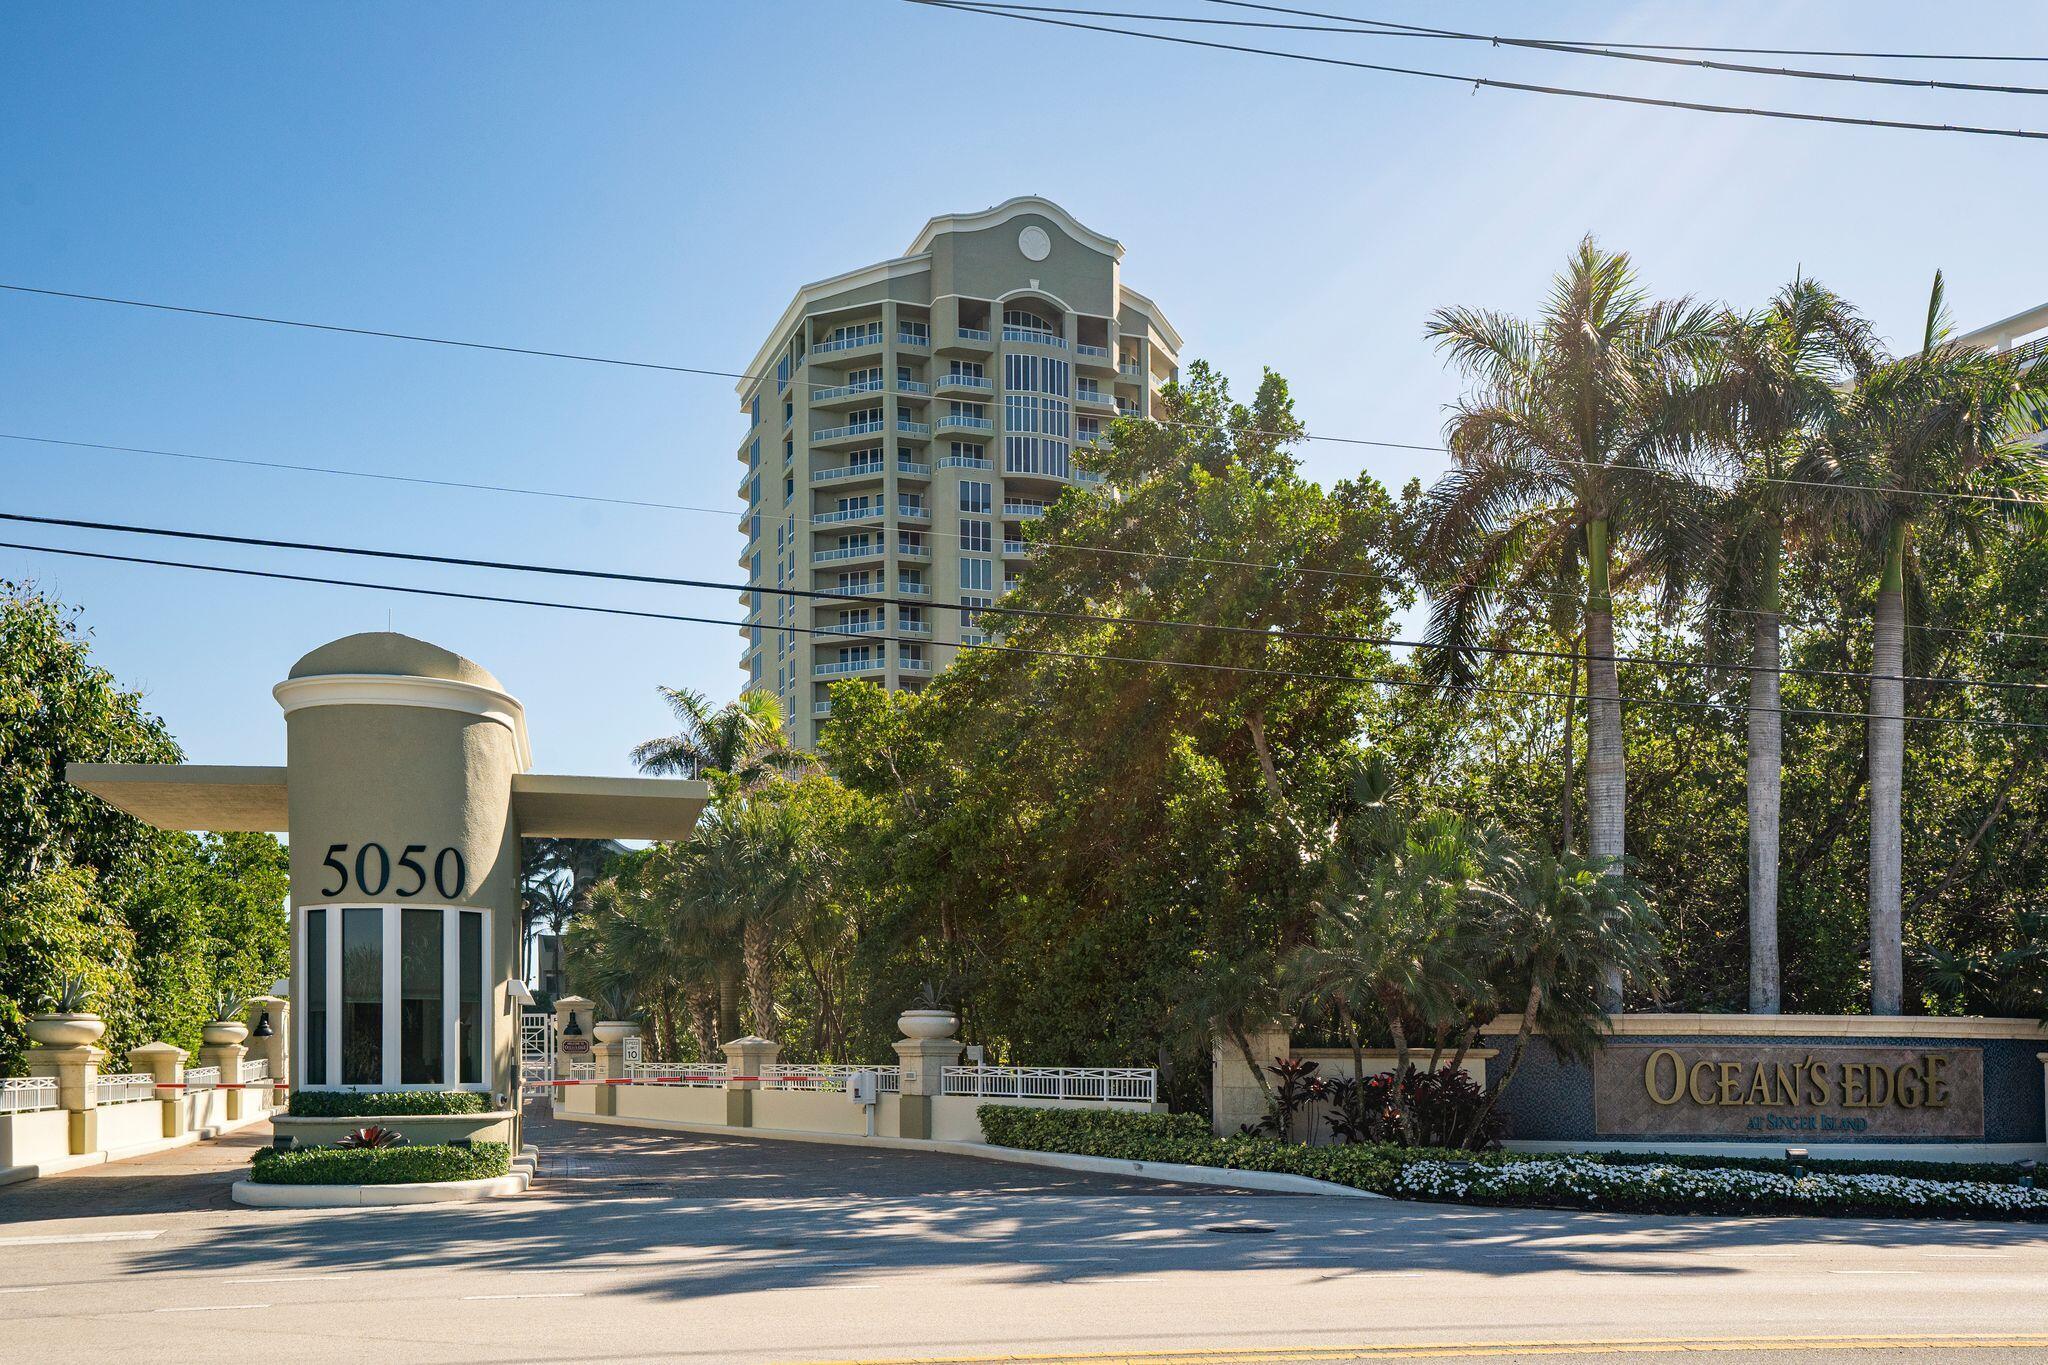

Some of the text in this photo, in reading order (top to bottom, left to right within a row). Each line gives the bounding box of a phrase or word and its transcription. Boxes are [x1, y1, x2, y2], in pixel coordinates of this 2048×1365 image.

[321, 842, 465, 899] 5050
[628, 1050, 637, 1058] 10
[1644, 1049, 1950, 1108] OCEAN'S EDGE
[1766, 1111, 1817, 1130] SINGER
[1820, 1113, 1868, 1132] ISLAND
